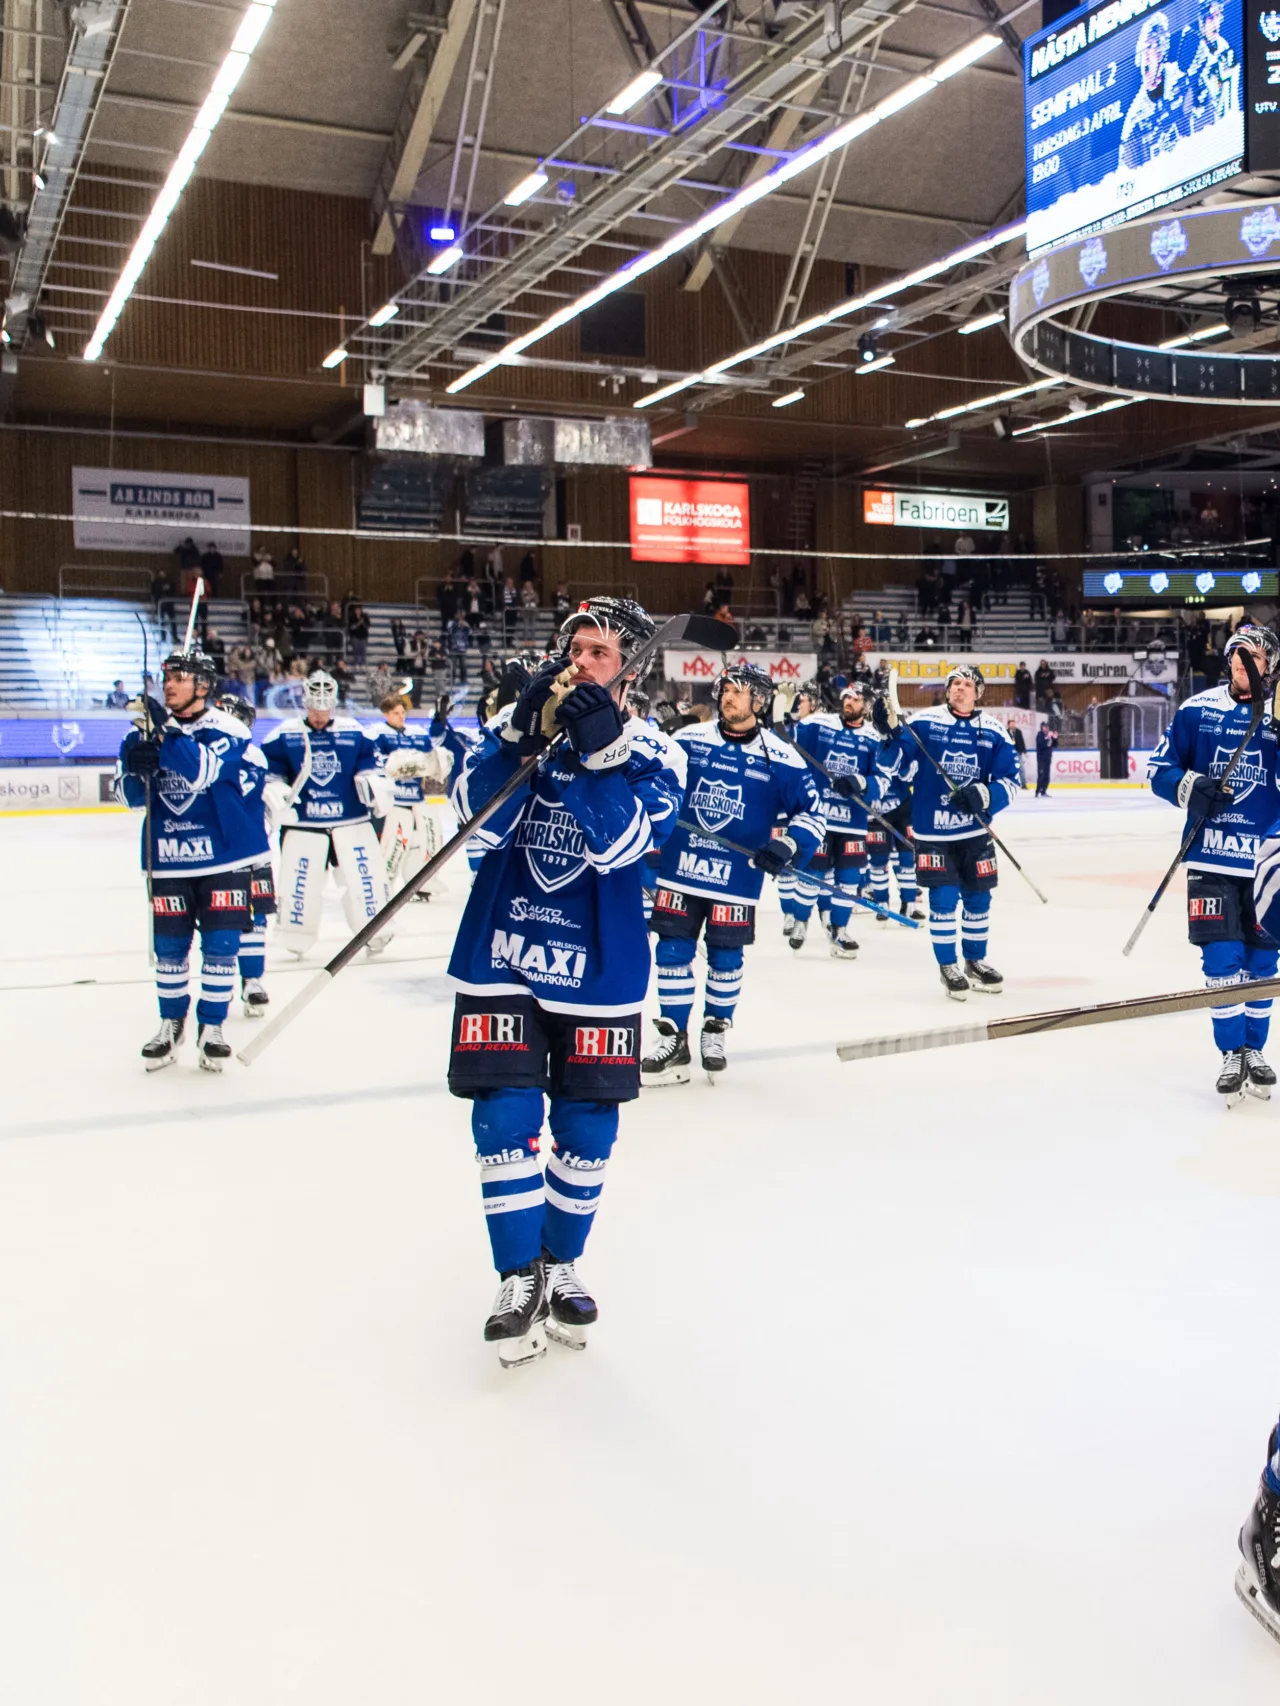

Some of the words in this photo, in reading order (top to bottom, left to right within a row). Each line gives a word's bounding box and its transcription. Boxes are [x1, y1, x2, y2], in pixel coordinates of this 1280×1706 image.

[1031, 70, 1104, 130] SEMIFINAL
[1105, 62, 1117, 87] 2
[114, 487, 134, 501] AB
[137, 488, 181, 505] LINDS
[124, 507, 200, 520] KARLSKOGA
[663, 501, 742, 518] KARLSKOGA
[1082, 663, 1128, 678] Kuriren
[711, 761, 739, 774] Helmia
[0, 782, 50, 798] skoga
[306, 801, 343, 816] MAXI
[689, 792, 745, 821] KARLSKOGA
[157, 838, 214, 858] MAXI
[515, 822, 586, 858] KARLSKO
[1203, 829, 1260, 855] MAXI
[542, 853, 568, 867] 1978
[1211, 848, 1257, 861] STORMARKNA
[678, 850, 732, 881] MAXI
[354, 846, 376, 917] Helmia
[290, 857, 309, 926] Helmia
[528, 904, 562, 916] AUTO
[491, 929, 587, 979] MAXI
[547, 939, 586, 953] KARLSKOGA
[454, 1043, 481, 1052] ROAD
[485, 1043, 529, 1052] RENTAL
[567, 1055, 597, 1065] ROAD
[600, 1055, 637, 1066] RENTAL
